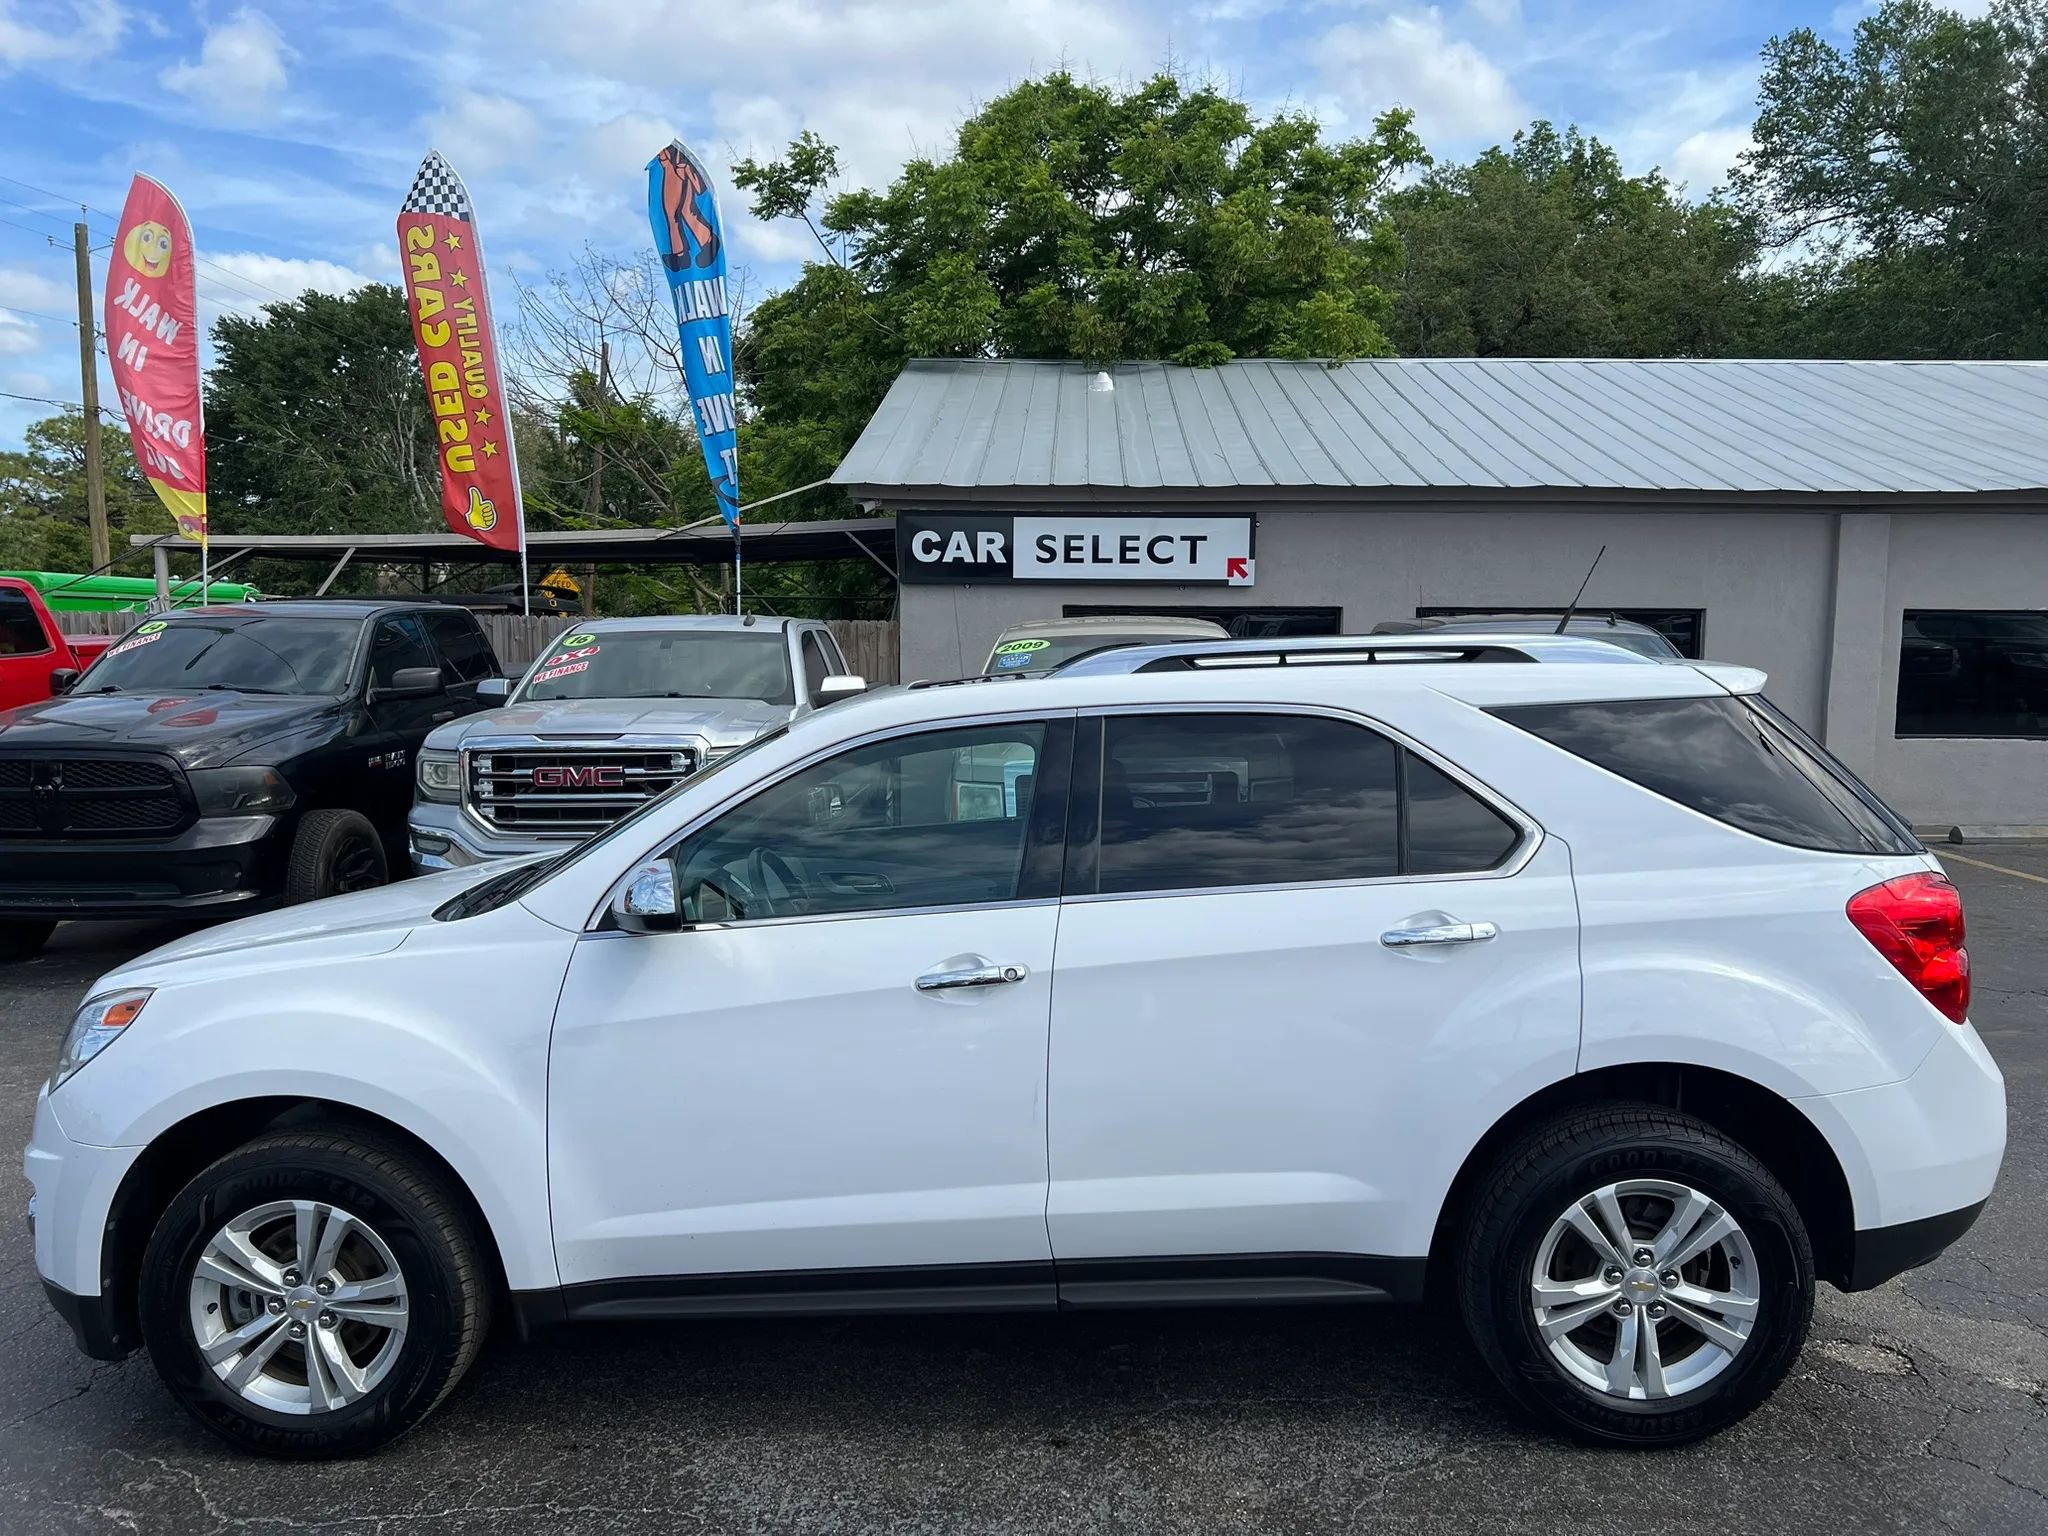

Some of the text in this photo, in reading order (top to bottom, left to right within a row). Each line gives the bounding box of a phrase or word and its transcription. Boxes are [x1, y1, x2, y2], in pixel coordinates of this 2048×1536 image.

[911, 530, 1209, 565] CAR SELECT
[568, 635, 591, 645] 16
[1000, 641, 1044, 653] 2009
[534, 662, 588, 683] WE FINANCE
[534, 766, 623, 787] GMC
